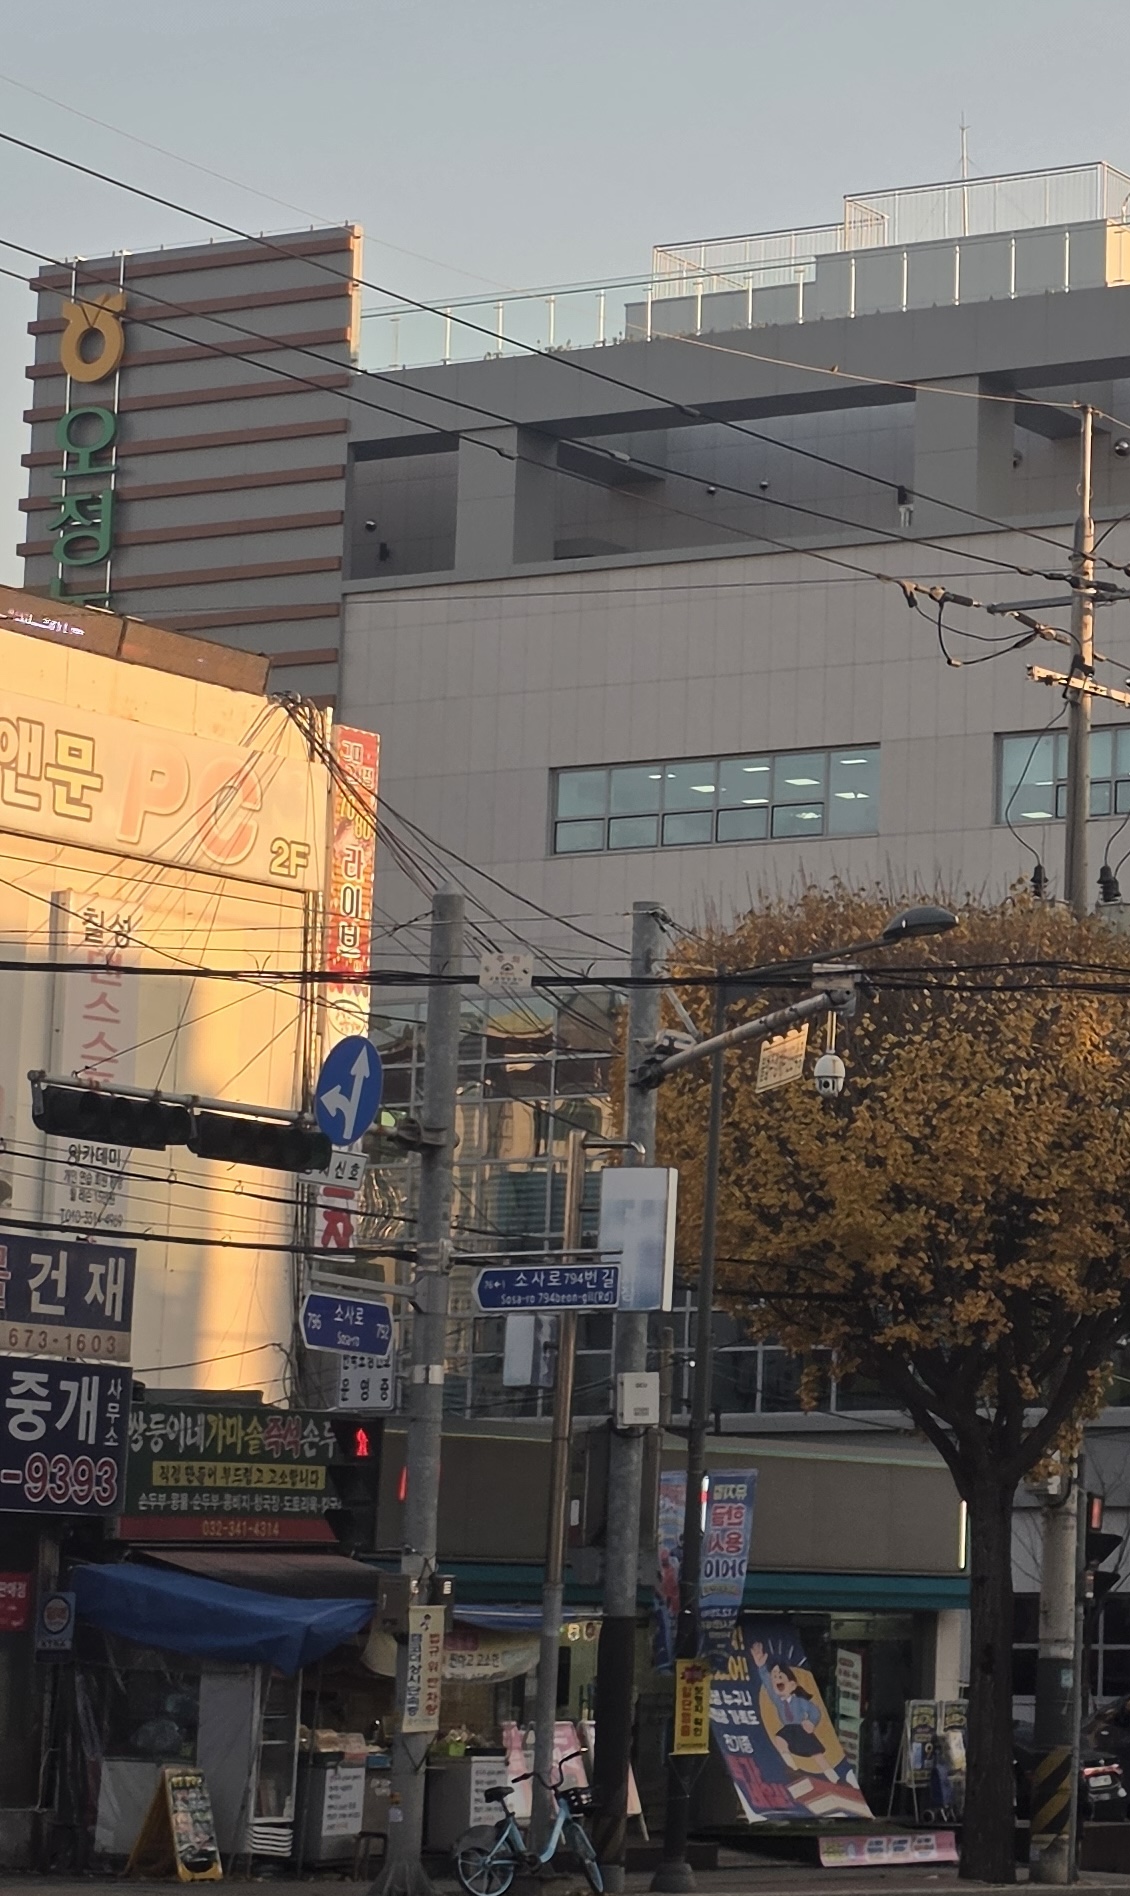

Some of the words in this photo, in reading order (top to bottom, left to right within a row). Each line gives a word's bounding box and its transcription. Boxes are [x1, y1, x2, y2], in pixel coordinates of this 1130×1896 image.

[115, 742, 264, 866] PC
[269, 836, 310, 878] 2F
[28, 1250, 127, 1323] 건재
[333, 1303, 365, 1326] 소사로
[8, 1326, 117, 1352] 673-1603
[5, 1370, 101, 1446] 중개
[103, 1378, 124, 1448] 사무소
[206, 1413, 265, 1455] 가마솥
[202, 1519, 280, 1538] 032-341-4314
